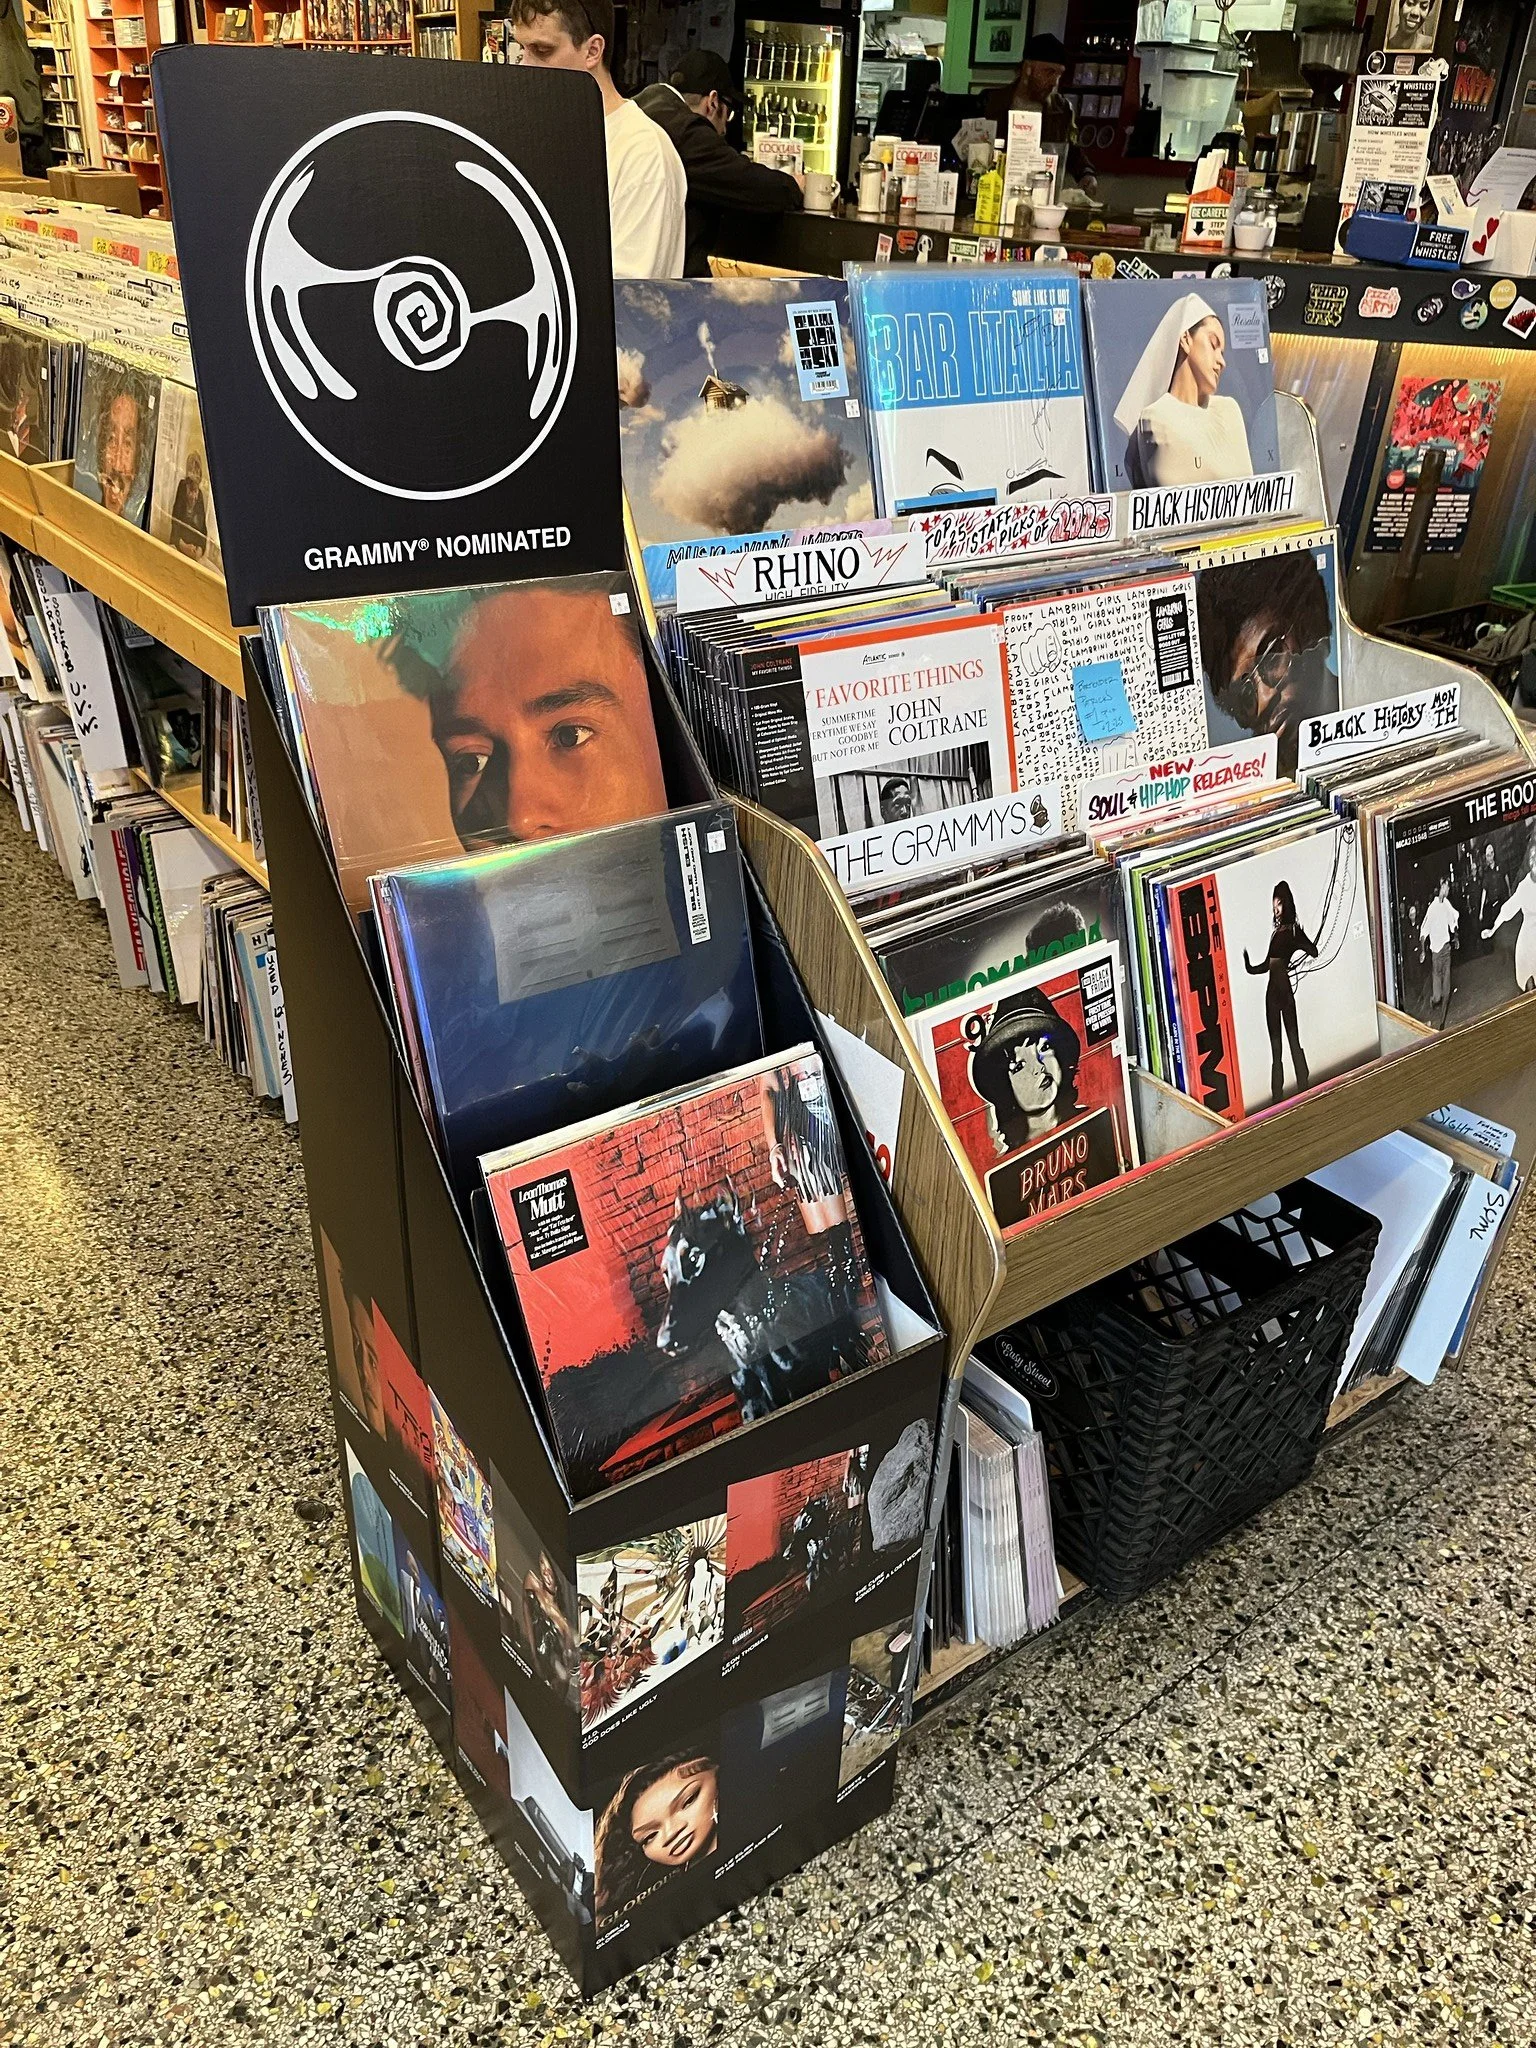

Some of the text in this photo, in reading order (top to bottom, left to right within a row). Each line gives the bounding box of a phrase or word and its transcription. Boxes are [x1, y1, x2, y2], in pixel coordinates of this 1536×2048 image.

[1403, 82, 1434, 91] WHISTLES!
[759, 142, 801, 154] COCKTAILS
[1429, 231, 1453, 244] FREE
[1415, 246, 1459, 261] WHISTLES
[1012, 288, 1070, 306] SOME LIKE IT HOT
[1309, 283, 1349, 298] THIRD
[873, 312, 960, 402] BAR
[968, 308, 1080, 397] ITALIA
[1133, 475, 1294, 532] BLACK HISTORY MONTH
[925, 505, 1013, 559] TOP 25 STAFF
[999, 500, 1111, 547] PICKS OF 2025
[303, 525, 571, 571] GRAMMY® NOMINATED
[1260, 534, 1337, 558] HANCOCK
[752, 546, 860, 593] RHINO
[765, 589, 793, 602] HIGH
[1040, 584, 1192, 619] LAMBRINI GIRLS LAMBRINI GIRLS
[1155, 601, 1183, 618] LAMBRINI
[1004, 612, 1034, 625] FRONT
[1004, 622, 1034, 635] COVER
[1087, 618, 1112, 631] GIRLS
[1156, 617, 1174, 632] GIRLS
[1069, 634, 1137, 659] LAMBRINI GIRLS
[816, 658, 985, 709] FAVORITE THINGS
[1033, 675, 1060, 687] GIRLS
[821, 708, 876, 727] SUMMERTIME
[887, 696, 943, 724] JOHN
[1307, 687, 1458, 748] BLACK HISTORY MON
[1434, 704, 1459, 730] TH
[809, 720, 877, 741] ERYTIME WE SAY
[838, 731, 879, 746] GOODBYE
[888, 708, 989, 746] COLTRANE
[812, 740, 880, 763] BUT NOT FOR ME
[1149, 757, 1195, 781] NEW
[1088, 791, 1130, 822] SOUL
[1193, 752, 1267, 793] RELEASES!
[1465, 792, 1498, 824] THE
[826, 801, 1027, 884] THE GRAMMYS
[1204, 877, 1223, 953] THE
[1090, 967, 1109, 985] BLACK
[1090, 977, 1110, 995] FRIDAY
[1178, 882, 1231, 1116] BPM
[266, 955, 294, 1086] USED INCHES
[1431, 1105, 1474, 1135] SIGHT
[1019, 1130, 1090, 1200] BRUNO
[518, 1176, 568, 1204] Leon Thomas
[1026, 1168, 1088, 1218] MARS
[529, 1190, 566, 1221] Mutt
[1000, 1341, 1053, 1389] Easy Street
[854, 1584, 876, 1603] SONGS
[890, 1559, 907, 1576] LOST
[855, 1571, 885, 1597] THE CURE
[721, 1633, 769, 1671] LEON THOMAS
[721, 1660, 740, 1677] MUTT
[582, 1694, 658, 1750] GOD DOES LIKE UGLY
